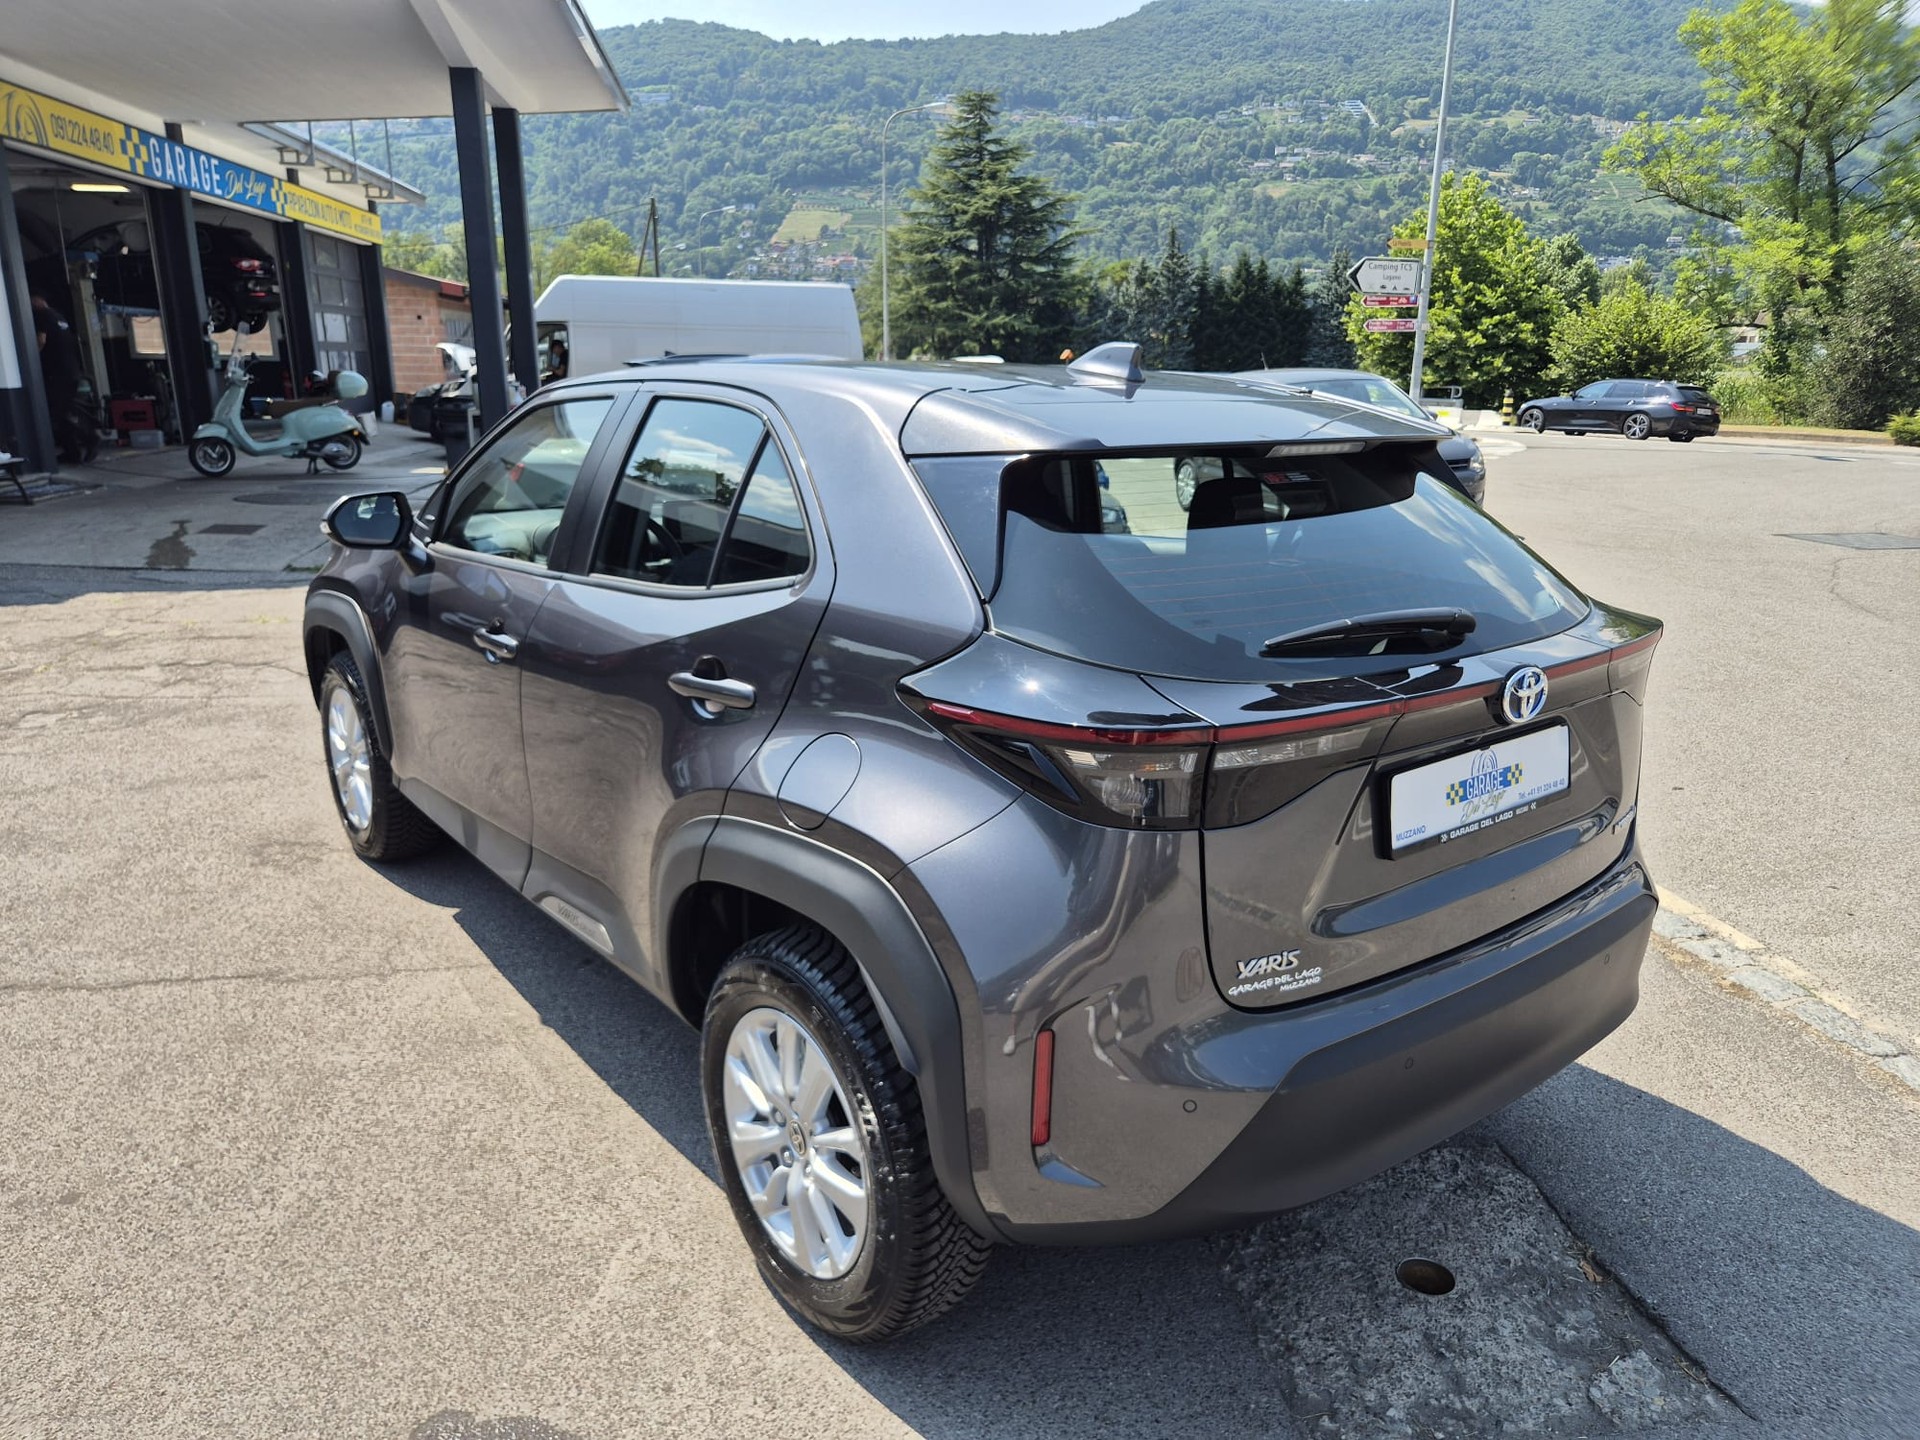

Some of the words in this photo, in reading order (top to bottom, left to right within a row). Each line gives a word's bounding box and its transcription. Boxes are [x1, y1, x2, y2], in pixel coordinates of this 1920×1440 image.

[149, 137, 223, 195] GARAGE
[224, 169, 245, 200] Del
[1368, 262, 1399, 272] Camping
[1400, 263, 1413, 271] TCS
[1466, 769, 1505, 799] GARAGE
[1396, 825, 1426, 841] MUZZANO
[1450, 822, 1480, 839] GARAGE
[1480, 818, 1494, 829] DEL
[1495, 811, 1514, 823] LAGO
[1237, 948, 1301, 979] YARIS
[1228, 977, 1273, 996] GARAGE
[1274, 974, 1294, 986] DEL
[1295, 966, 1321, 979] LAGO
[1280, 976, 1321, 992] MUZZANO
